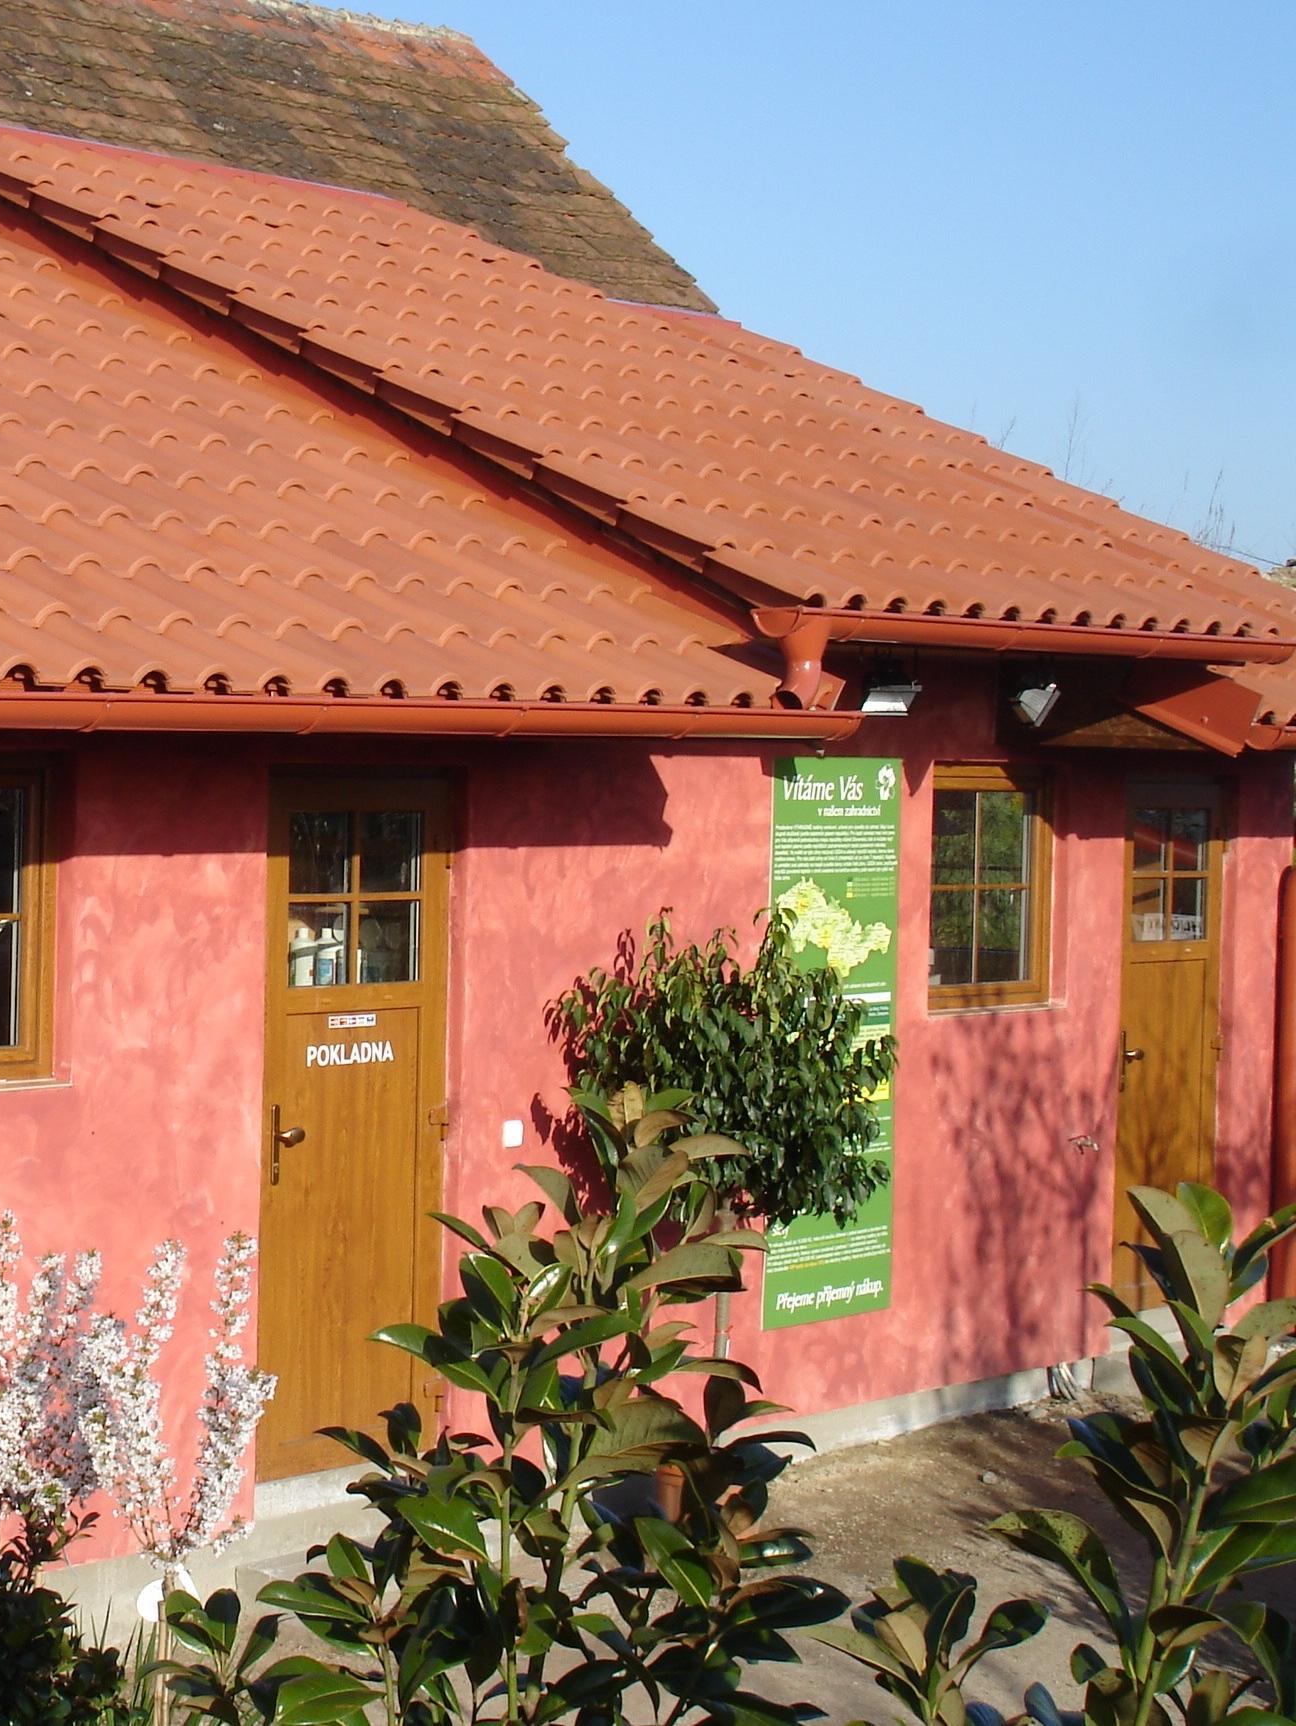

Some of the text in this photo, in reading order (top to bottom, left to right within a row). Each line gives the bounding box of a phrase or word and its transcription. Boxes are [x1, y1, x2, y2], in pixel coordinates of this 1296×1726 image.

[783, 774, 863, 800] Vítáme Vás
[817, 804, 881, 816] v našem zahradnictví
[306, 1040, 394, 1068] POKLADNA
[776, 1277, 883, 1313] Přejeme příjemný nákup.
